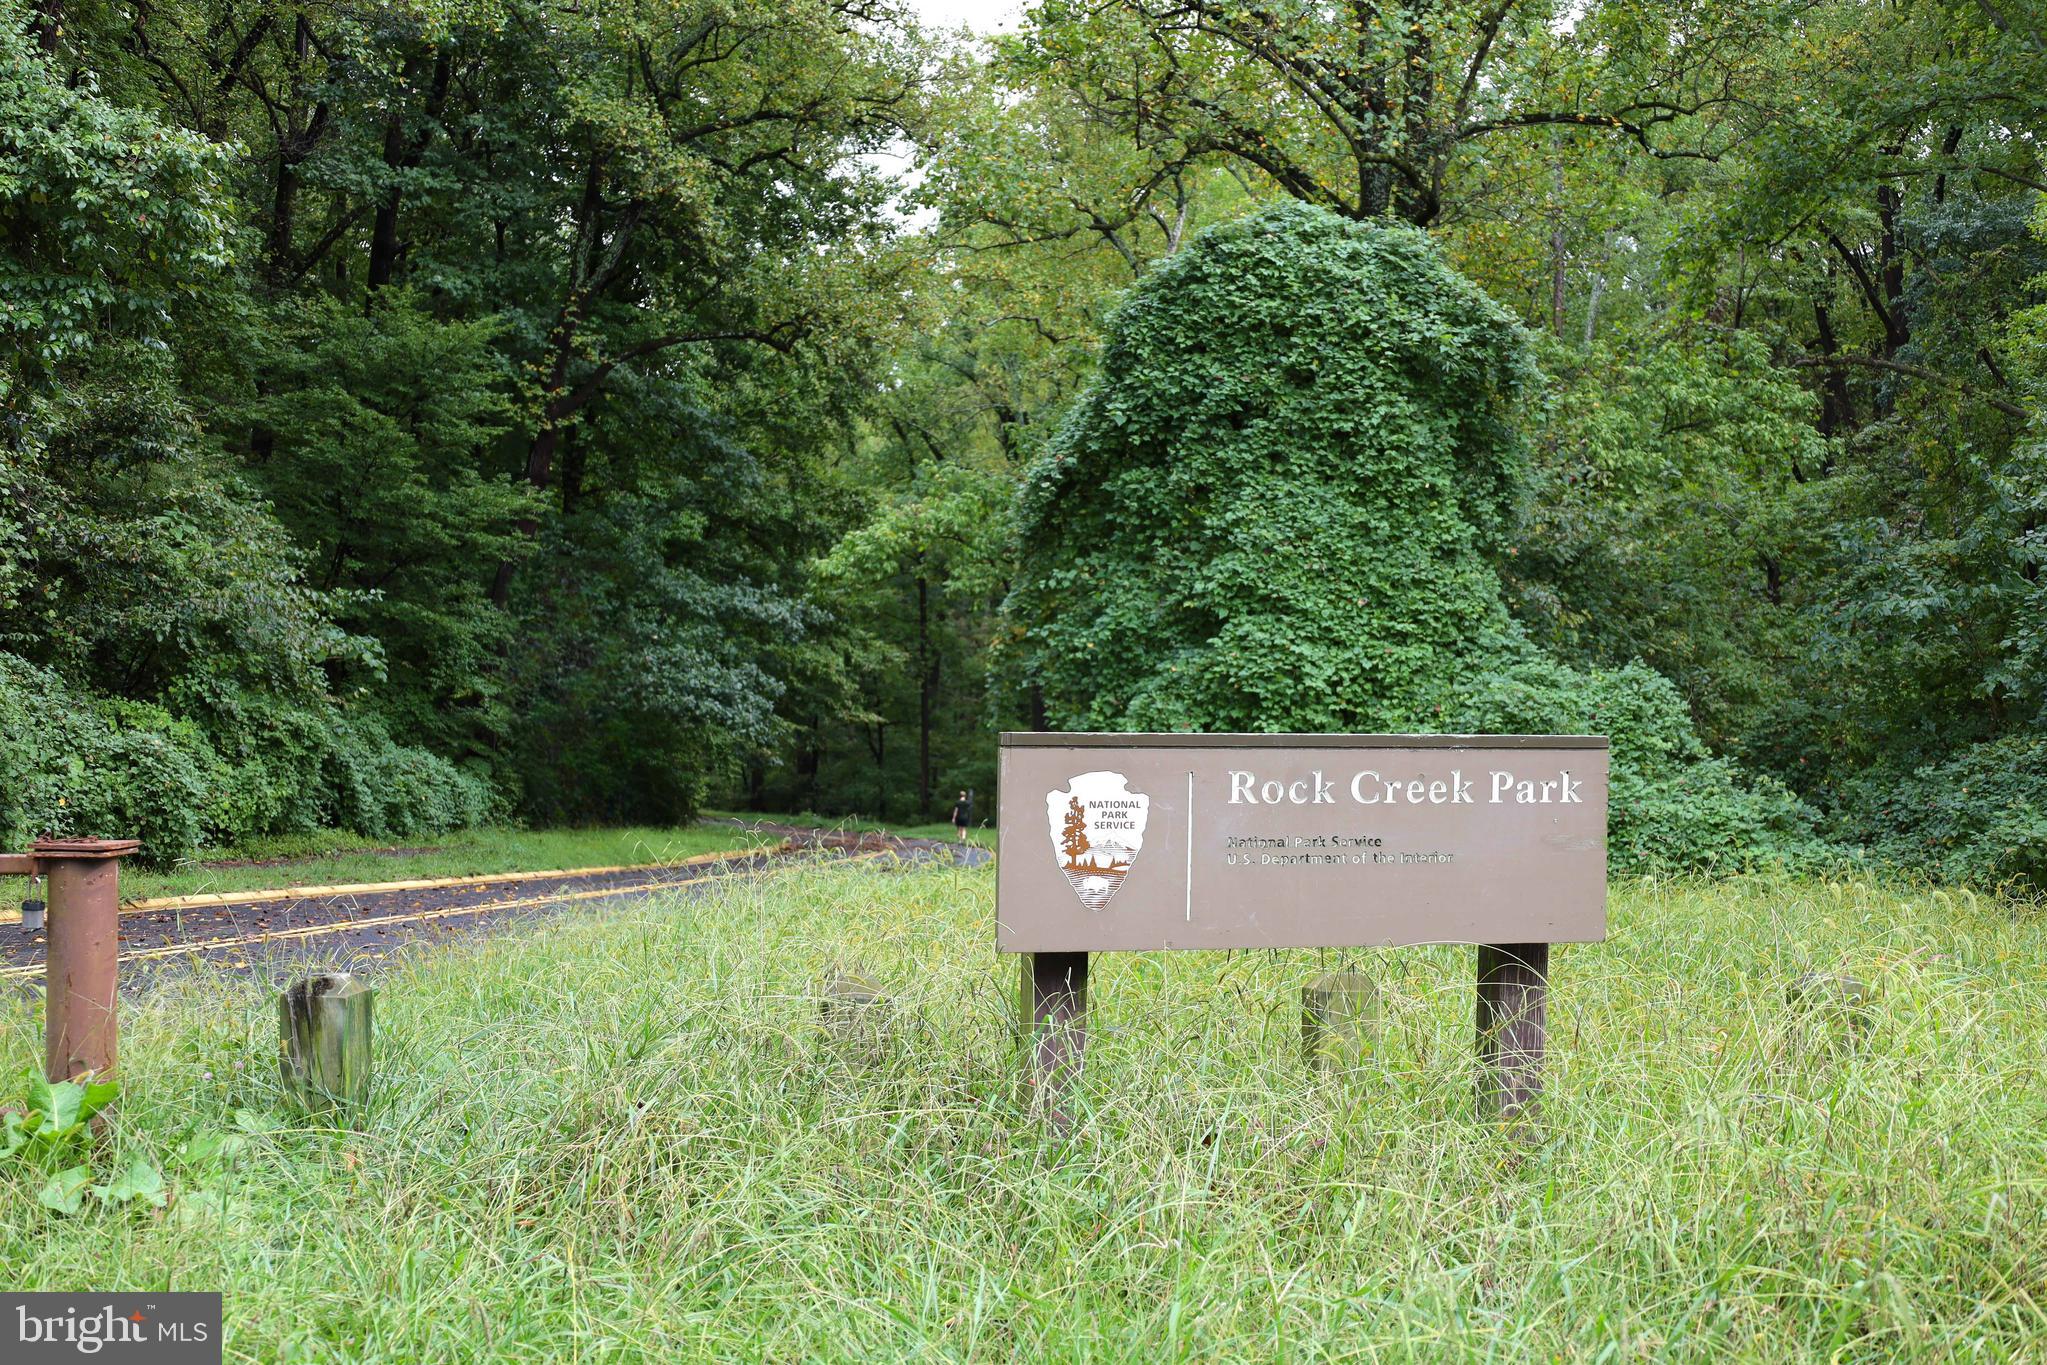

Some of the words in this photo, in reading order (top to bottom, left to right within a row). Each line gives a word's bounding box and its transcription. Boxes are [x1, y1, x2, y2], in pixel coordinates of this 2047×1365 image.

[1228, 769, 1336, 804] Rock
[1350, 769, 1475, 804] Creek
[1488, 769, 1583, 804] Park
[1089, 800, 1141, 809] NATIONAL
[1101, 811, 1128, 819] PARK
[1094, 821, 1135, 830] SERVICE
[1228, 836, 1290, 848] National
[1295, 836, 1326, 848] Park
[1331, 836, 1382, 847] Service
[1227, 853, 1256, 865] U.S.
[1261, 853, 1347, 867] Department
[1352, 852, 1368, 865] of
[1373, 852, 1395, 864] the
[1400, 851, 1454, 864] Interior
